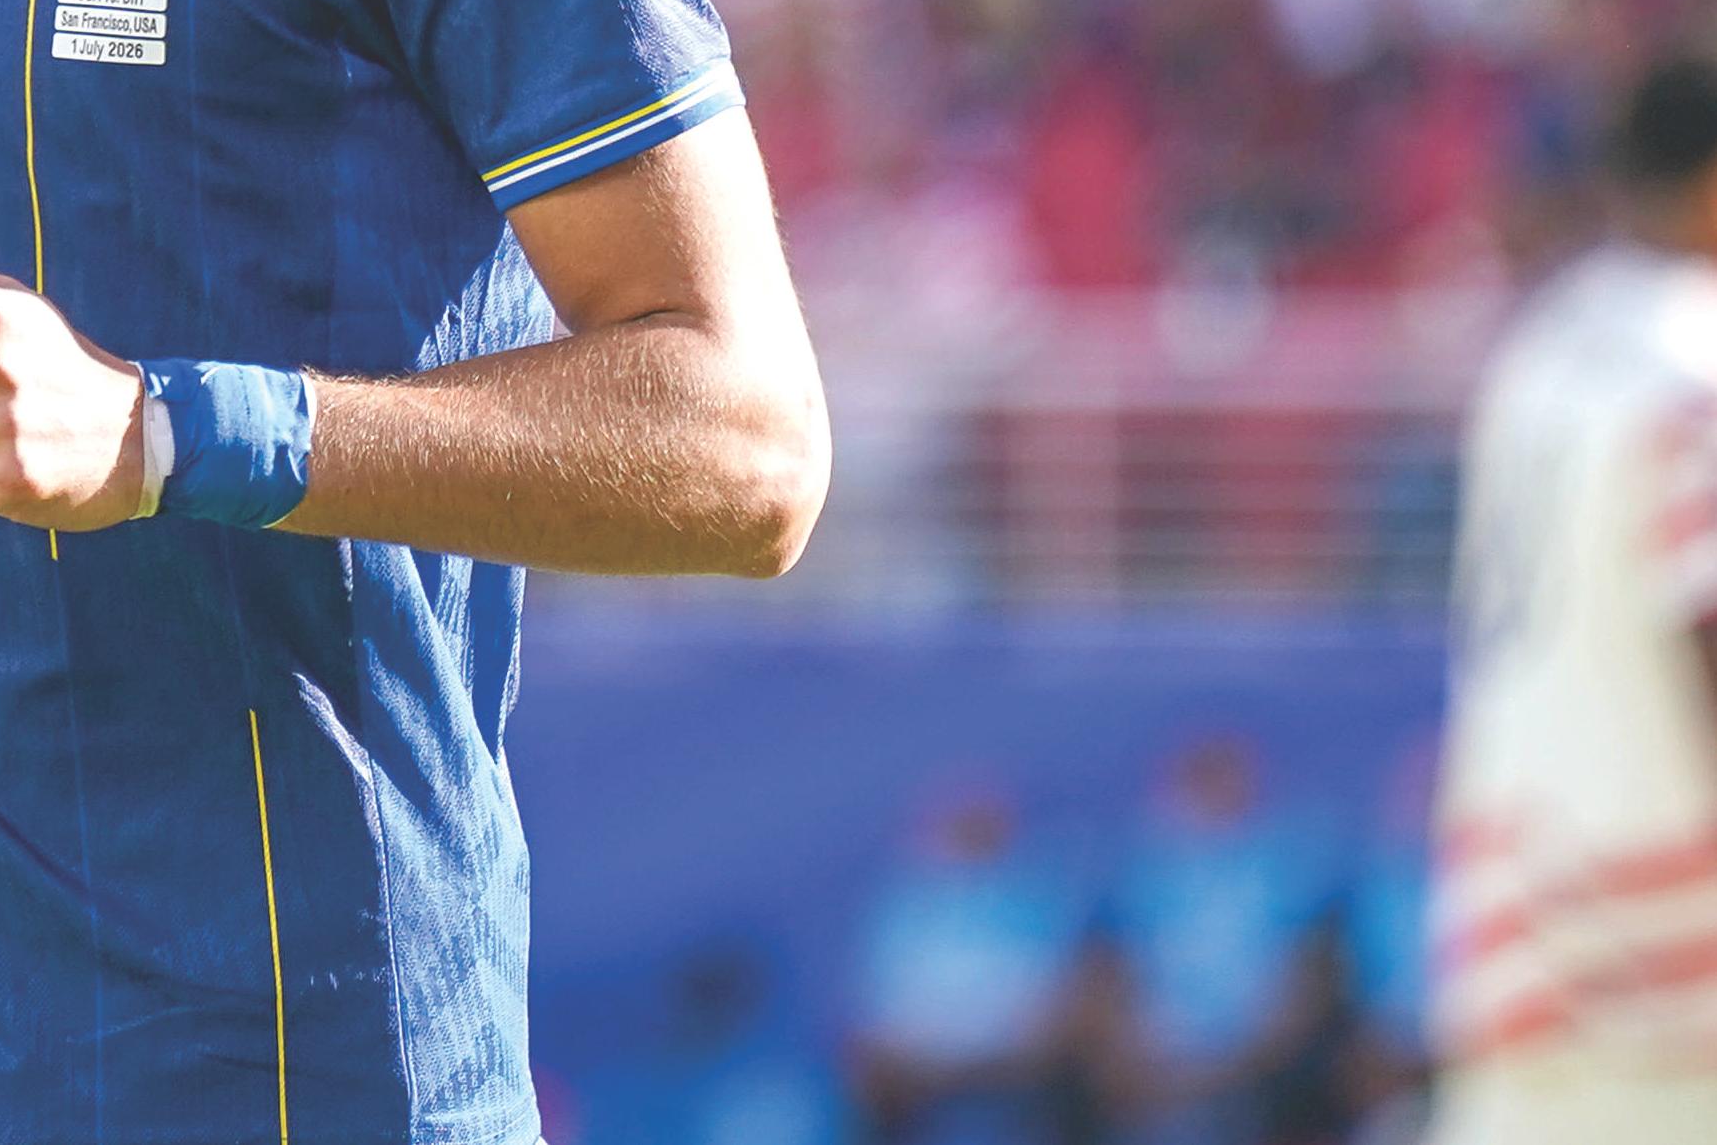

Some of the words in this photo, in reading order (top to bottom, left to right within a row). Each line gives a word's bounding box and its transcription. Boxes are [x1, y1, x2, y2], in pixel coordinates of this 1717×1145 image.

[61, 10, 80, 28] San
[71, 38, 78, 54] 1
[79, 39, 105, 61] July
[108, 41, 144, 59] 2026
